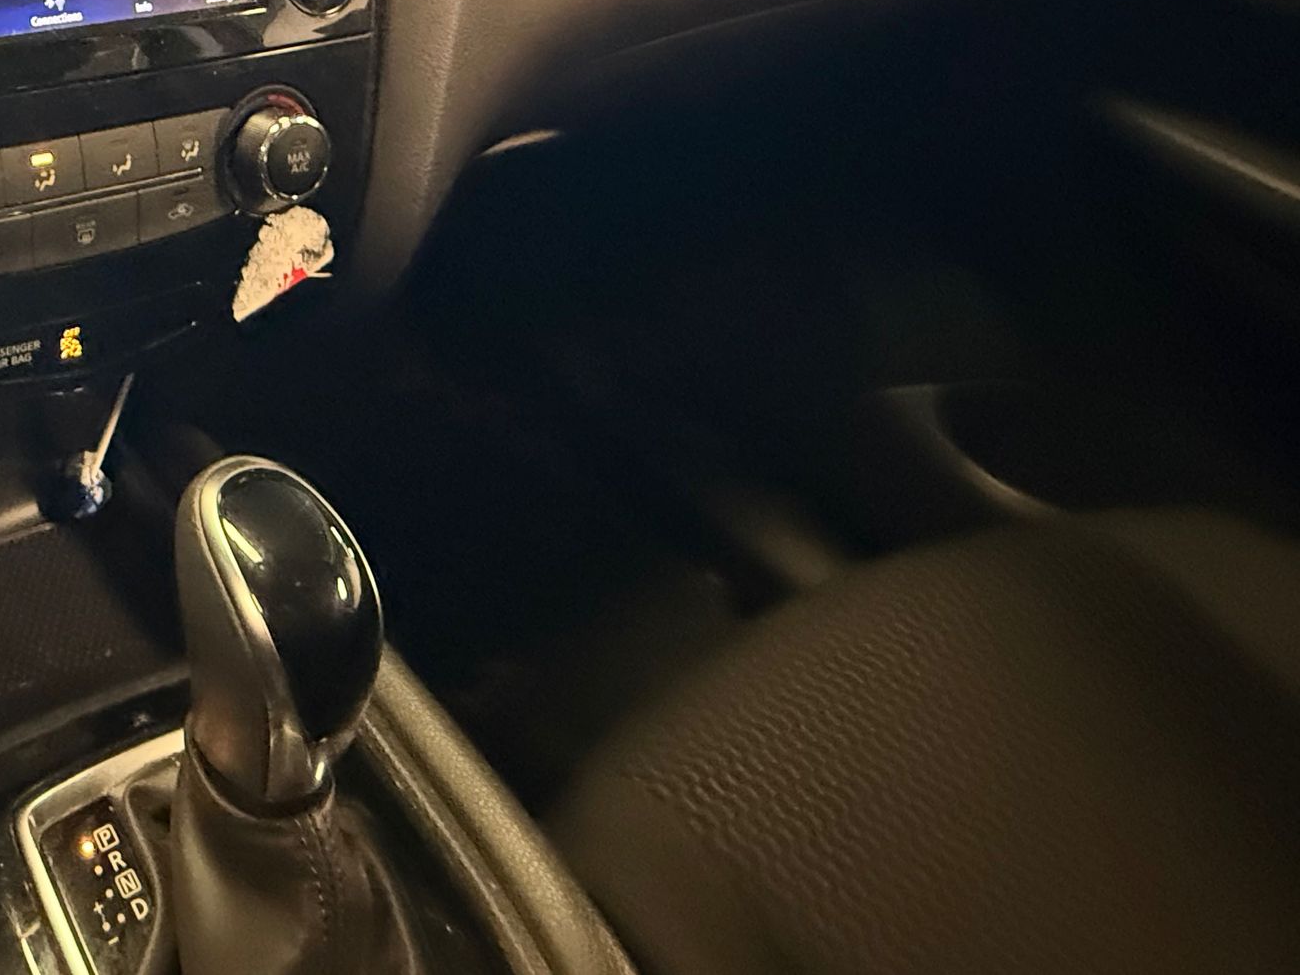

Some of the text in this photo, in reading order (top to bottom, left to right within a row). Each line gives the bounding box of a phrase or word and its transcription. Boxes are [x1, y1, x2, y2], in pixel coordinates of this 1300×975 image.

[10, 352, 33, 366] BAG
[108, 850, 128, 872] R
[130, 898, 149, 921] D
